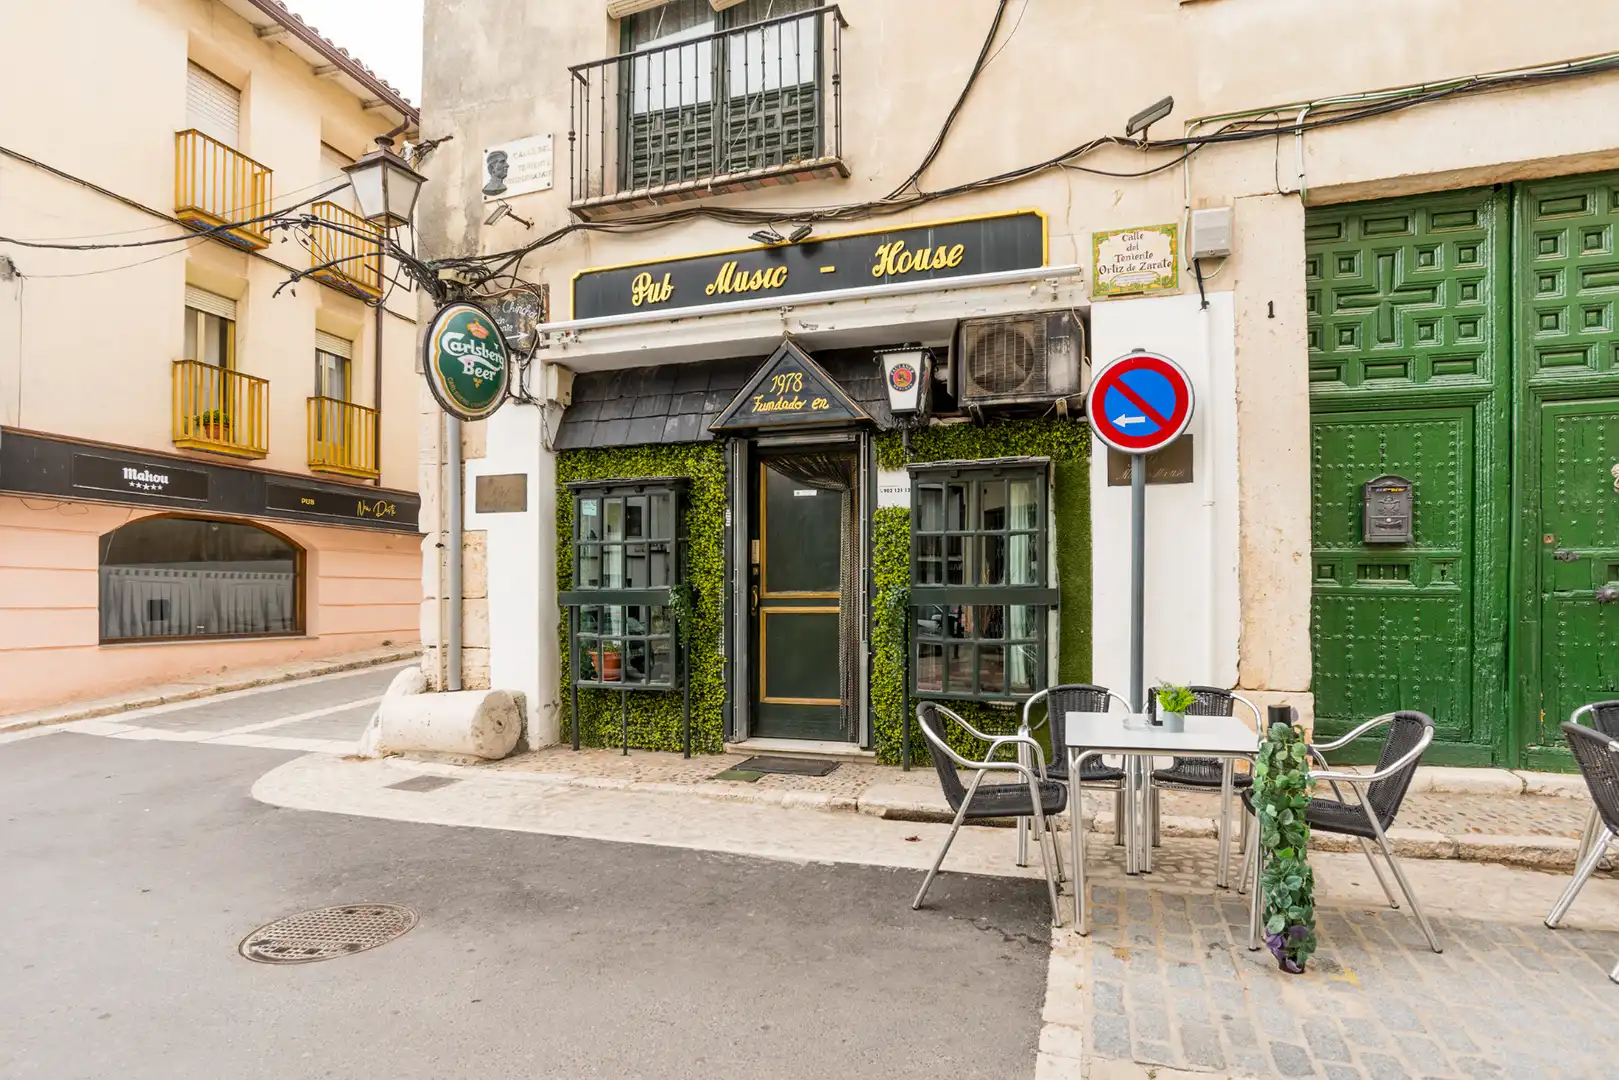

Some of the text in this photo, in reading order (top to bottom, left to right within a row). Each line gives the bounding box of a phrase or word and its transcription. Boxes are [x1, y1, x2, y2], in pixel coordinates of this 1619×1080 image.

[1121, 231, 1144, 242] Calle
[1126, 242, 1139, 252] del
[1114, 250, 1153, 263] Teniente
[631, 272, 675, 307] Pub
[705, 260, 788, 296] Music
[872, 240, 965, 278] House
[1098, 258, 1172, 275] Ortiz de Zarate
[1267, 300, 1275, 318] 1
[441, 332, 504, 371] Carlsberg
[462, 359, 496, 381] Beer
[769, 372, 803, 396] 1978
[751, 394, 830, 413] Fundado en
[122, 467, 169, 484] Mahou
[301, 497, 315, 505] PUB
